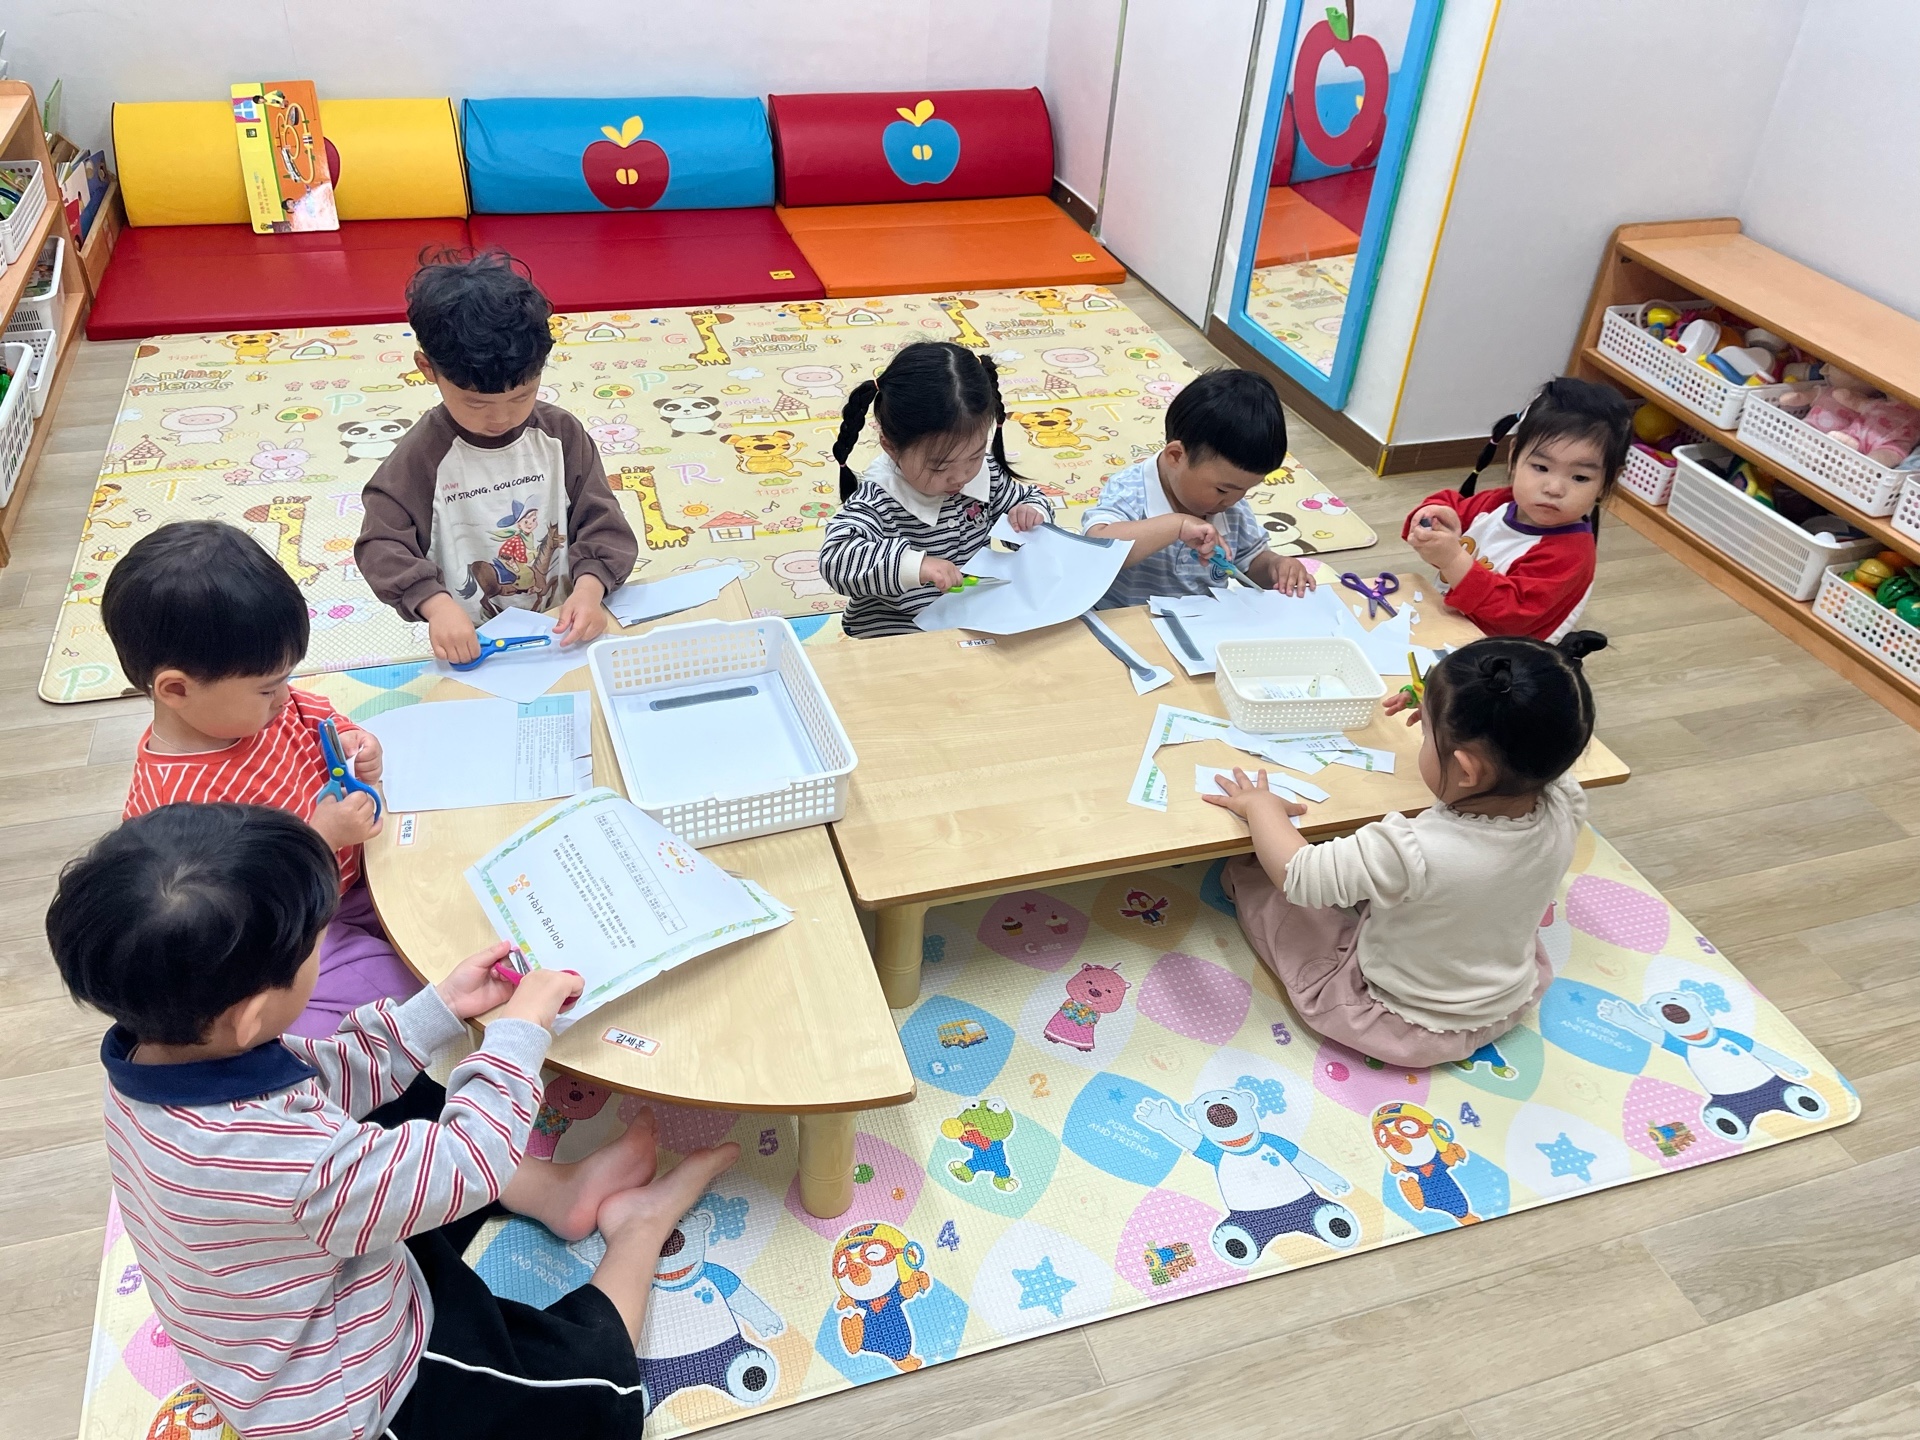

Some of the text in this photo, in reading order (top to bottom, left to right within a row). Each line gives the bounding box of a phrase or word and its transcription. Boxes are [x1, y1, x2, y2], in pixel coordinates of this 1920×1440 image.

[661, 333, 691, 345] G
[732, 334, 809, 346] Animal
[732, 342, 819, 357] Friends
[377, 350, 407, 363] G
[133, 368, 232, 383] Animal
[127, 379, 234, 398] Friends
[1088, 402, 1126, 422] T
[667, 463, 723, 485] R
[459, 487, 491, 500] STRONG,
[755, 485, 800, 499] tiger
[58, 663, 112, 701] P
[526, 891, 564, 949] 아이사랑 서약서
[1271, 1023, 1291, 1046] 5
[1028, 1072, 1051, 1098] 2
[1459, 1101, 1481, 1127] 4
[758, 1128, 779, 1156] 5
[1088, 1122, 1160, 1160] AND FRIENDS
[1107, 1118, 1150, 1143] PORORO
[936, 1220, 961, 1251] 4
[116, 1263, 143, 1295] 5
[533, 1265, 571, 1294] FRIEND
